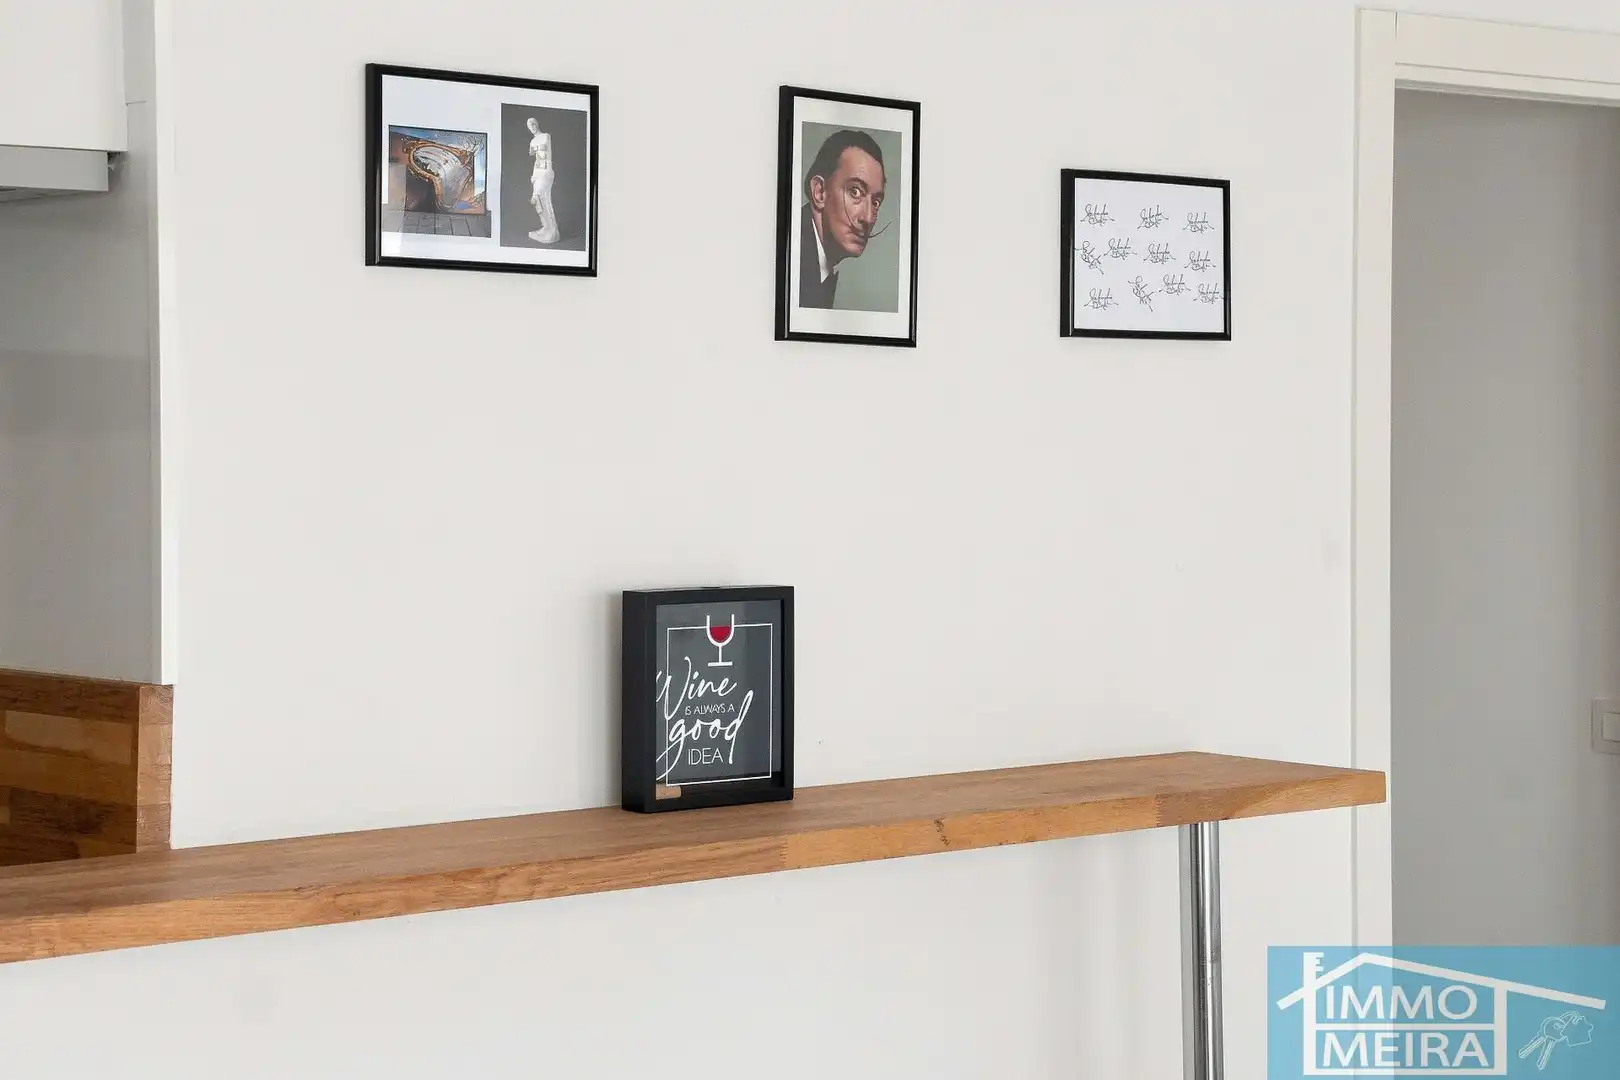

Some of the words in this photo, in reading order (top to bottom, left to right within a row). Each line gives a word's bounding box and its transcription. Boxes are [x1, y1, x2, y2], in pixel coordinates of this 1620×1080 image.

[656, 655, 737, 719] Wine
[694, 703, 726, 715] ALWAYS
[728, 703, 735, 712] A
[656, 690, 754, 781] good
[688, 748, 724, 765] IDEA
